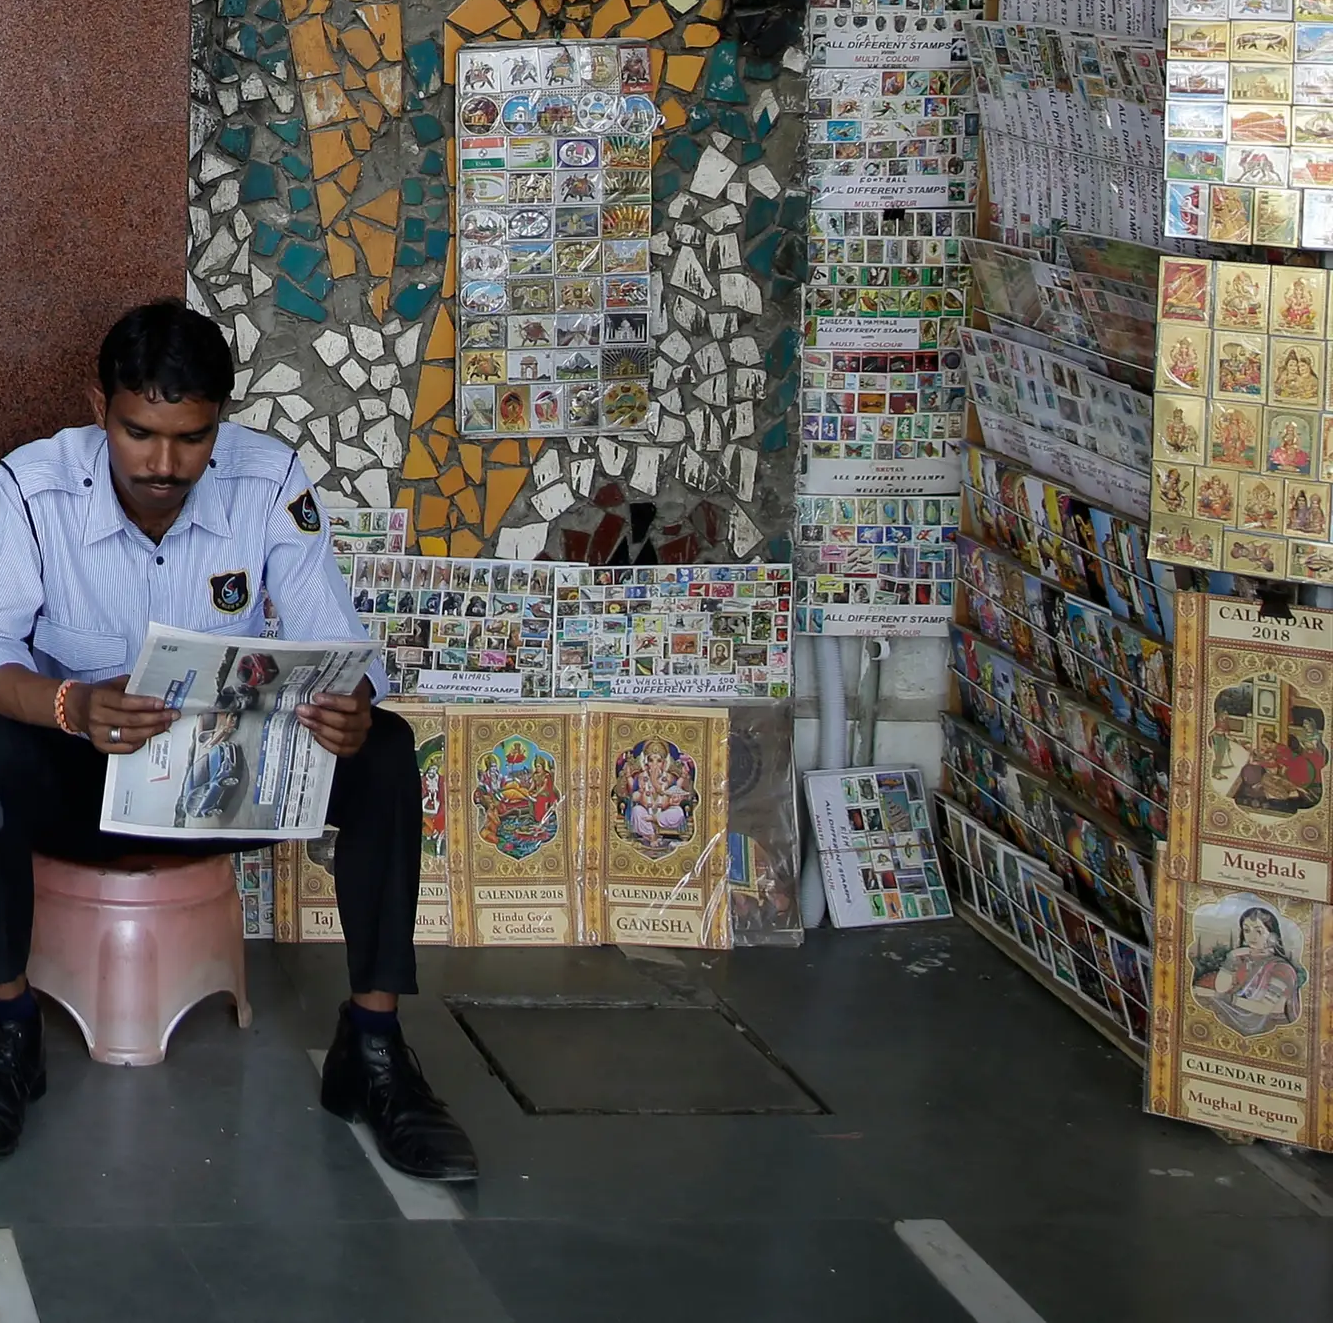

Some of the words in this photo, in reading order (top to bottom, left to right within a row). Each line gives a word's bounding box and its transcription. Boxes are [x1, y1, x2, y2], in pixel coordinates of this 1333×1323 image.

[847, 41, 907, 50] DIFFERENT
[910, 41, 952, 49] STAMPS
[846, 187, 905, 195] DIFFERENT
[906, 186, 947, 194] STAMPS
[854, 200, 879, 208] MULTI
[847, 614, 908, 623] DIFFERENT
[910, 615, 952, 624] STAMPS
[1252, 625, 1290, 642] 2018
[451, 672, 491, 682] ANIMALS
[418, 682, 437, 691] ALL
[439, 682, 482, 692] DIFFERENT
[483, 686, 519, 694] STAMPS
[609, 687, 630, 695] ALL
[632, 685, 693, 694] DIFFERENT
[696, 684, 738, 693] STAMPS
[824, 800, 832, 815] ALL
[838, 867, 851, 903] STAMPS
[1222, 850, 1306, 880] Mughals
[478, 889, 538, 900] CALENDAR
[540, 889, 563, 899] 2018
[612, 888, 672, 900] CALENDAR
[675, 891, 699, 902] 2018
[312, 911, 334, 928] Taj
[415, 914, 435, 926] dha
[492, 912, 524, 922] Hindu
[492, 925, 502, 934] &
[505, 924, 555, 934] Goddesses
[616, 917, 694, 934] GANESHA
[1186, 1058, 1266, 1085] CALENDAR
[1269, 1076, 1302, 1092] 2018
[1188, 1089, 1242, 1113] Mughal
[1248, 1103, 1298, 1125] Begum
